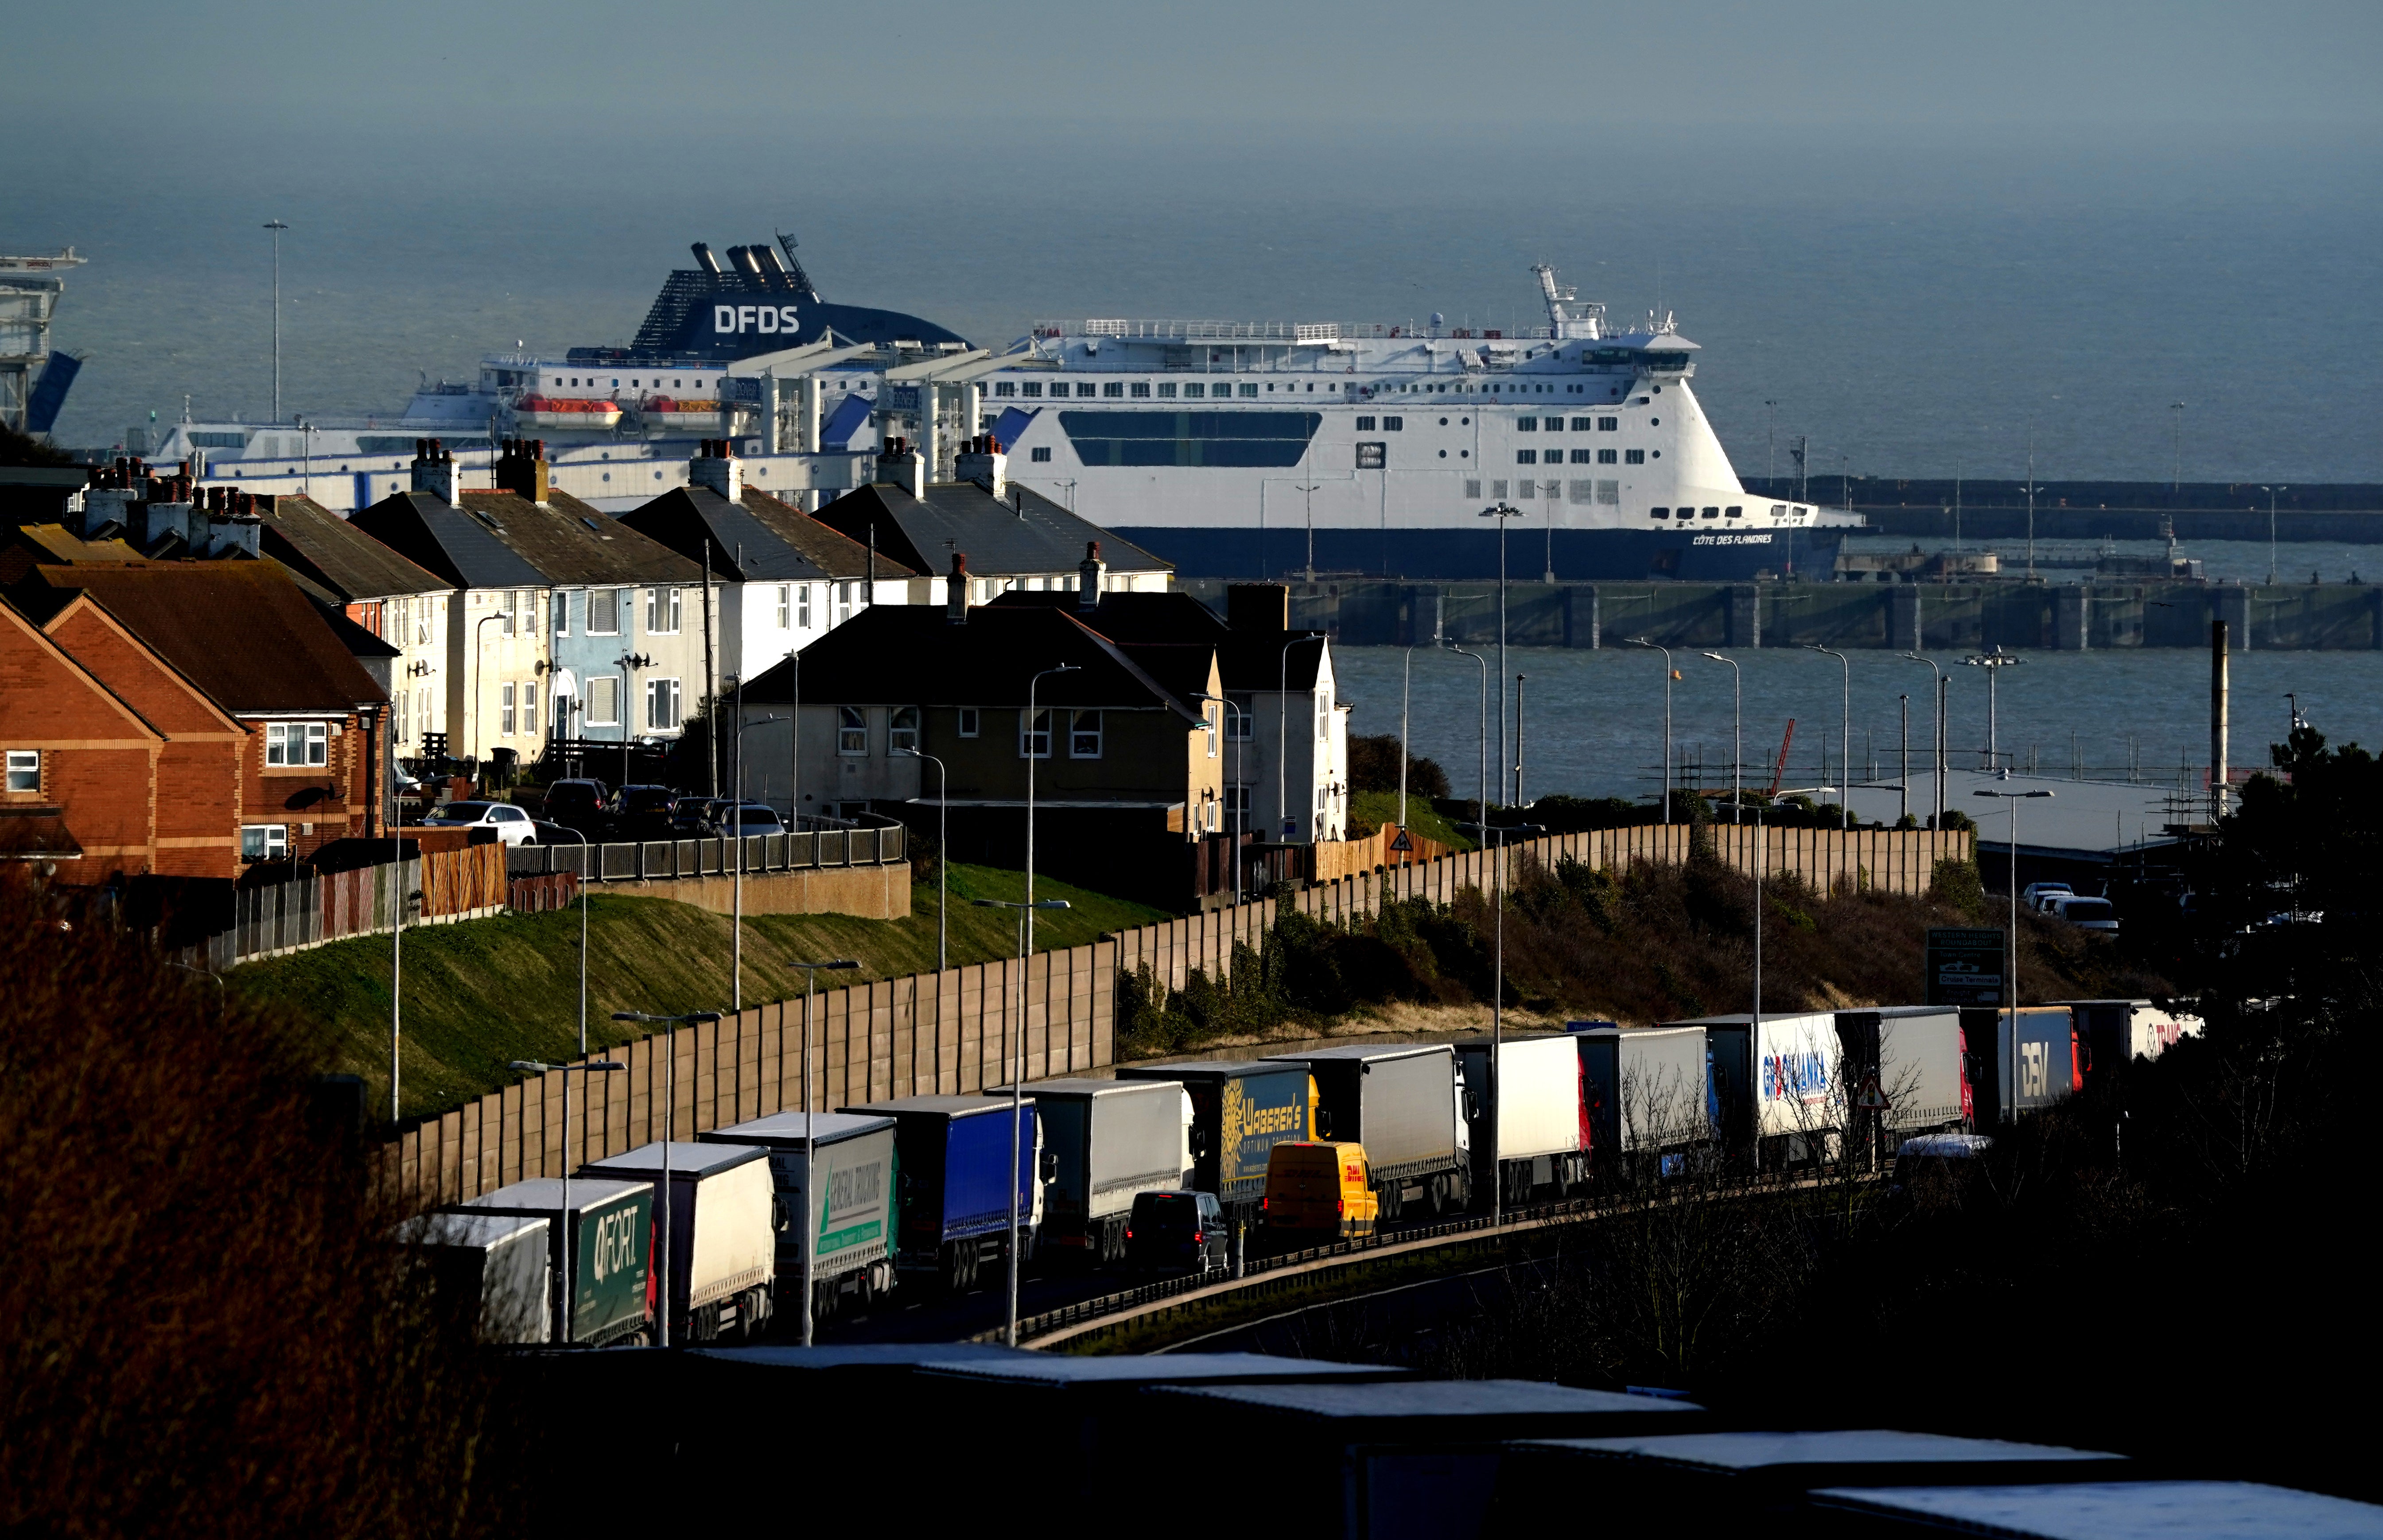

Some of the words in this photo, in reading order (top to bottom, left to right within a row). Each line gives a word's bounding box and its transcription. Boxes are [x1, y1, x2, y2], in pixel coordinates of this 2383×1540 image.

[715, 306, 799, 334] DFDS
[1693, 535, 1715, 545] CÔTE
[1716, 535, 1734, 545] DES
[1733, 534, 1772, 544] FLANDRES
[2022, 1041, 2049, 1097] DSV
[1242, 1093, 1302, 1136] WABERER'S
[1244, 1138, 1269, 1154] OPTIMUM
[830, 1168, 853, 1213] GENERAL
[854, 1161, 880, 1206] TRUCKING
[1346, 1165, 1363, 1182] DHL
